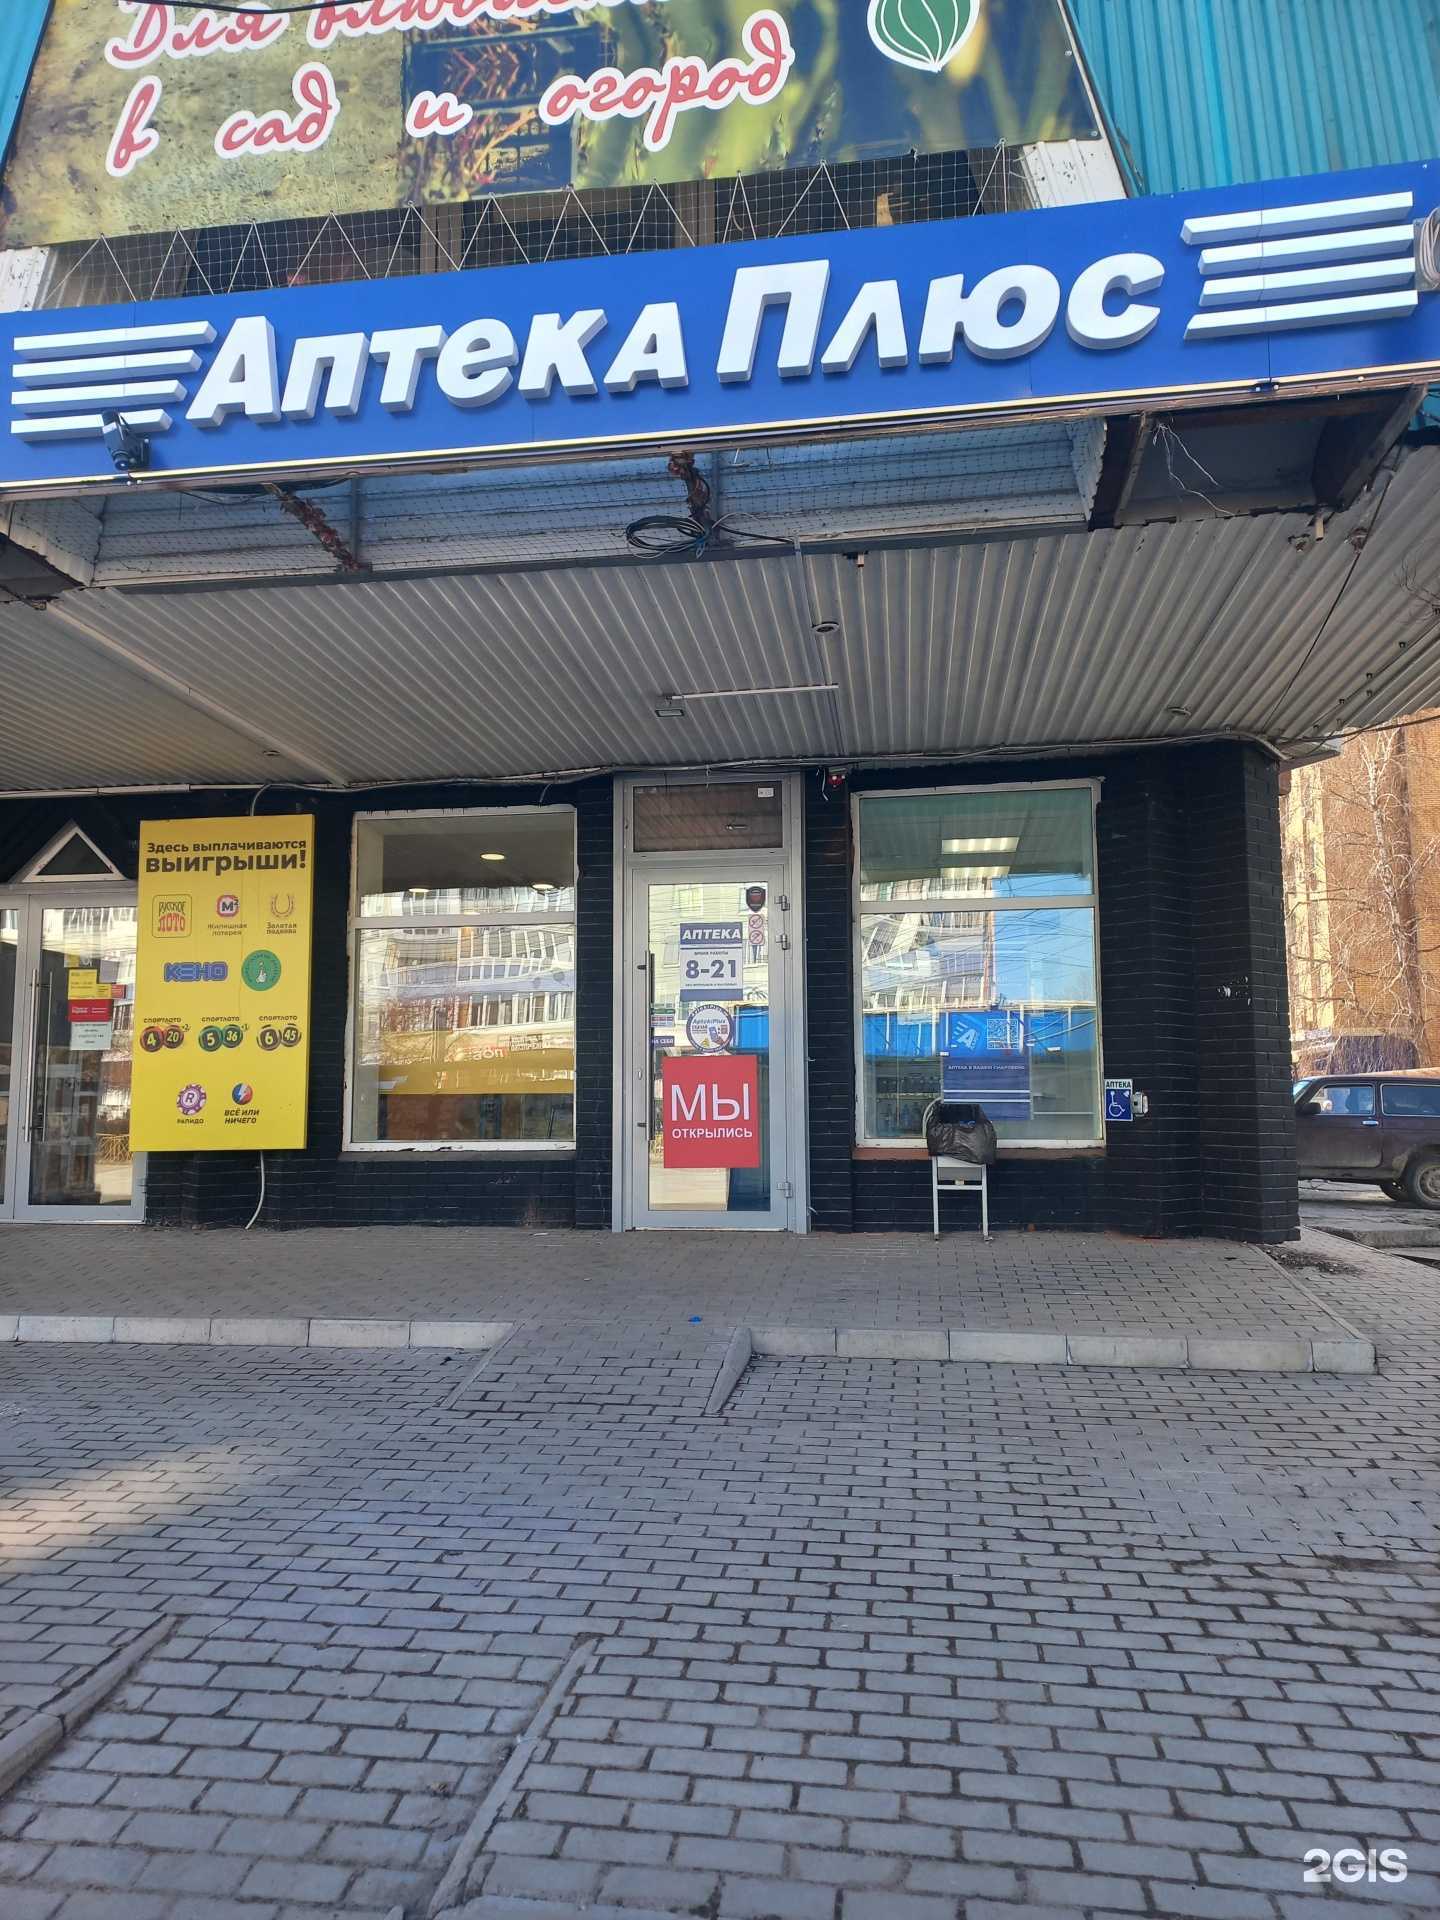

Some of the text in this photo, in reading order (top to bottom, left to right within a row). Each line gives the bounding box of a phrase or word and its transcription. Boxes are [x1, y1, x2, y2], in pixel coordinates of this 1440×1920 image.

[106, 1, 286, 64] Для
[109, 79, 158, 172] в
[219, 65, 336, 154] сад
[409, 94, 470, 133] и
[543, 14, 790, 147] огород
[147, 840, 306, 854] Здесь выплачиваются
[146, 850, 306, 876] выигрыши!
[157, 912, 187, 932] ЛОТО
[682, 928, 742, 940] АПТЕКА
[163, 961, 229, 982] КЕНО
[685, 959, 736, 979] 8-21
[147, 1033, 156, 1046] 4
[167, 1031, 179, 1042] 20
[206, 1033, 216, 1046] 5
[226, 1030, 238, 1042] 36
[265, 1029, 297, 1045] 6 45
[671, 1083, 750, 1121] МЫ
[241, 1108, 260, 1116] ИЛИ
[224, 1117, 257, 1125] НИЧЕГО
[672, 1127, 753, 1139] ОТКРЫЛИСЬ
